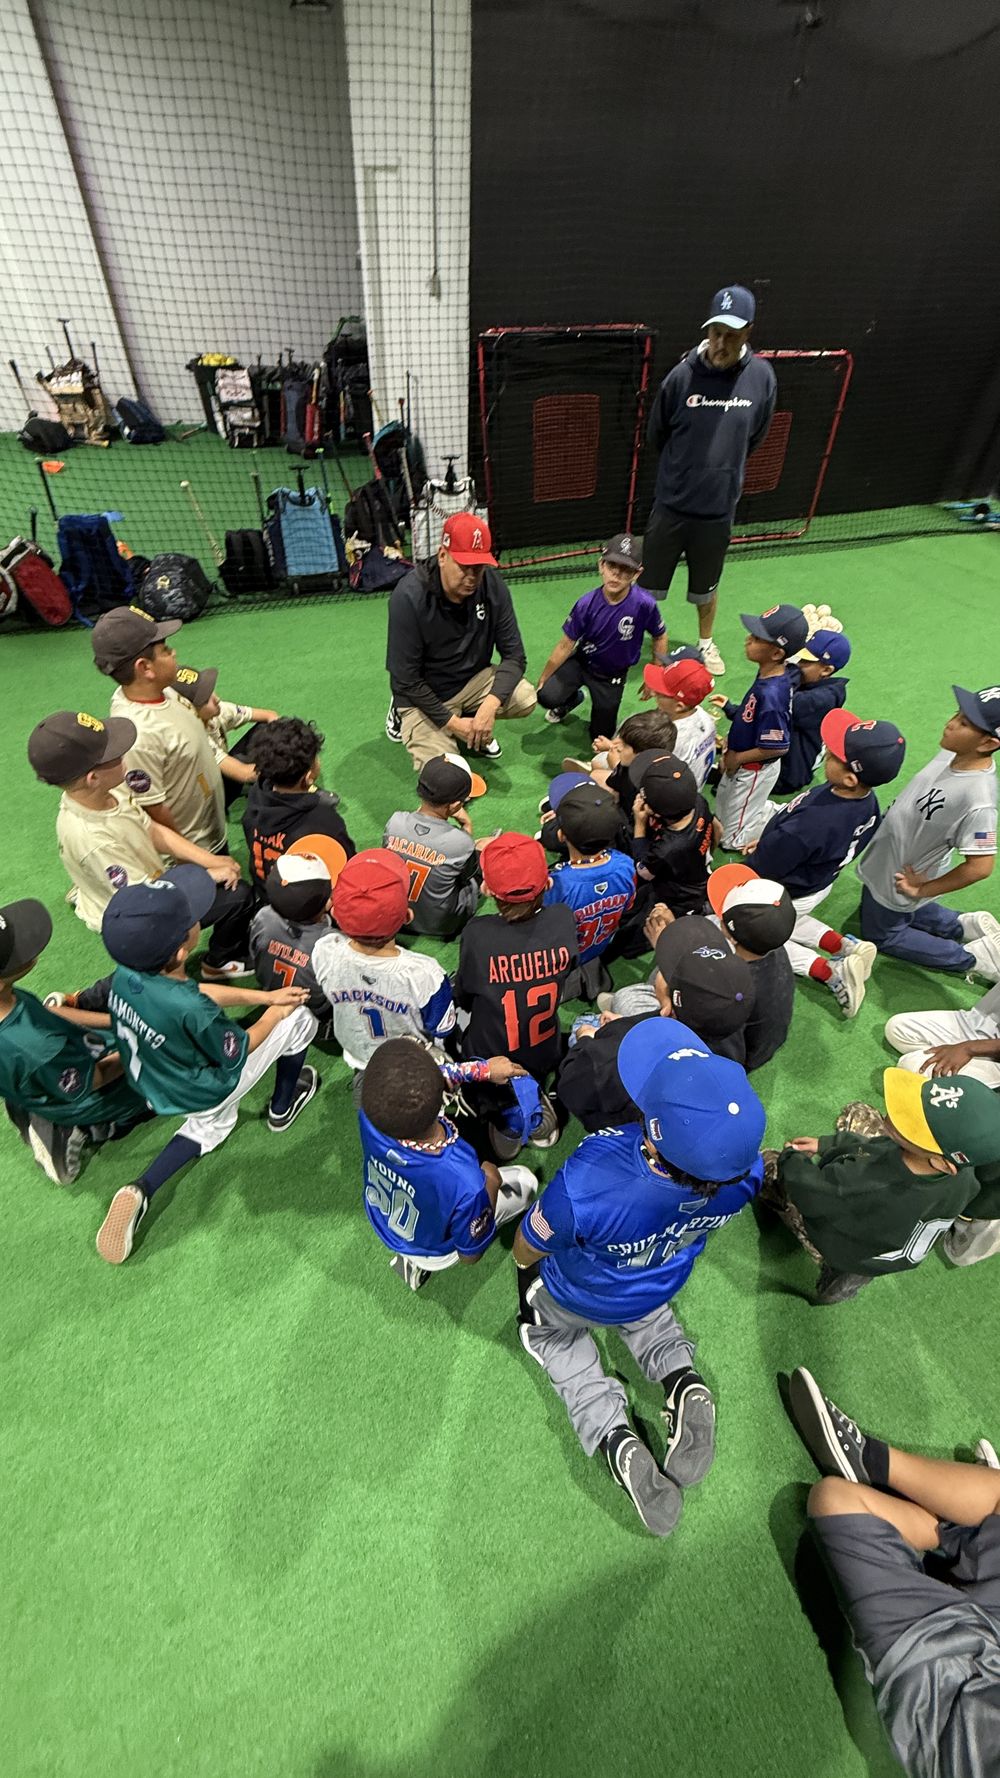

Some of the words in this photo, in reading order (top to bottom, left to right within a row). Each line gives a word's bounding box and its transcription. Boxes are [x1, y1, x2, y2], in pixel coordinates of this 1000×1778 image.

[686, 394, 752, 412] Champion
[916, 788, 946, 821] NY
[489, 946, 570, 984] ARGUELLO
[331, 989, 410, 1015] JACKSON
[501, 981, 558, 1052] 12
[360, 1006, 388, 1039] 1
[370, 1154, 416, 1199] YOUNG
[365, 1160, 419, 1242] 50
[607, 1209, 743, 1257] CRUZ-MARTIN
